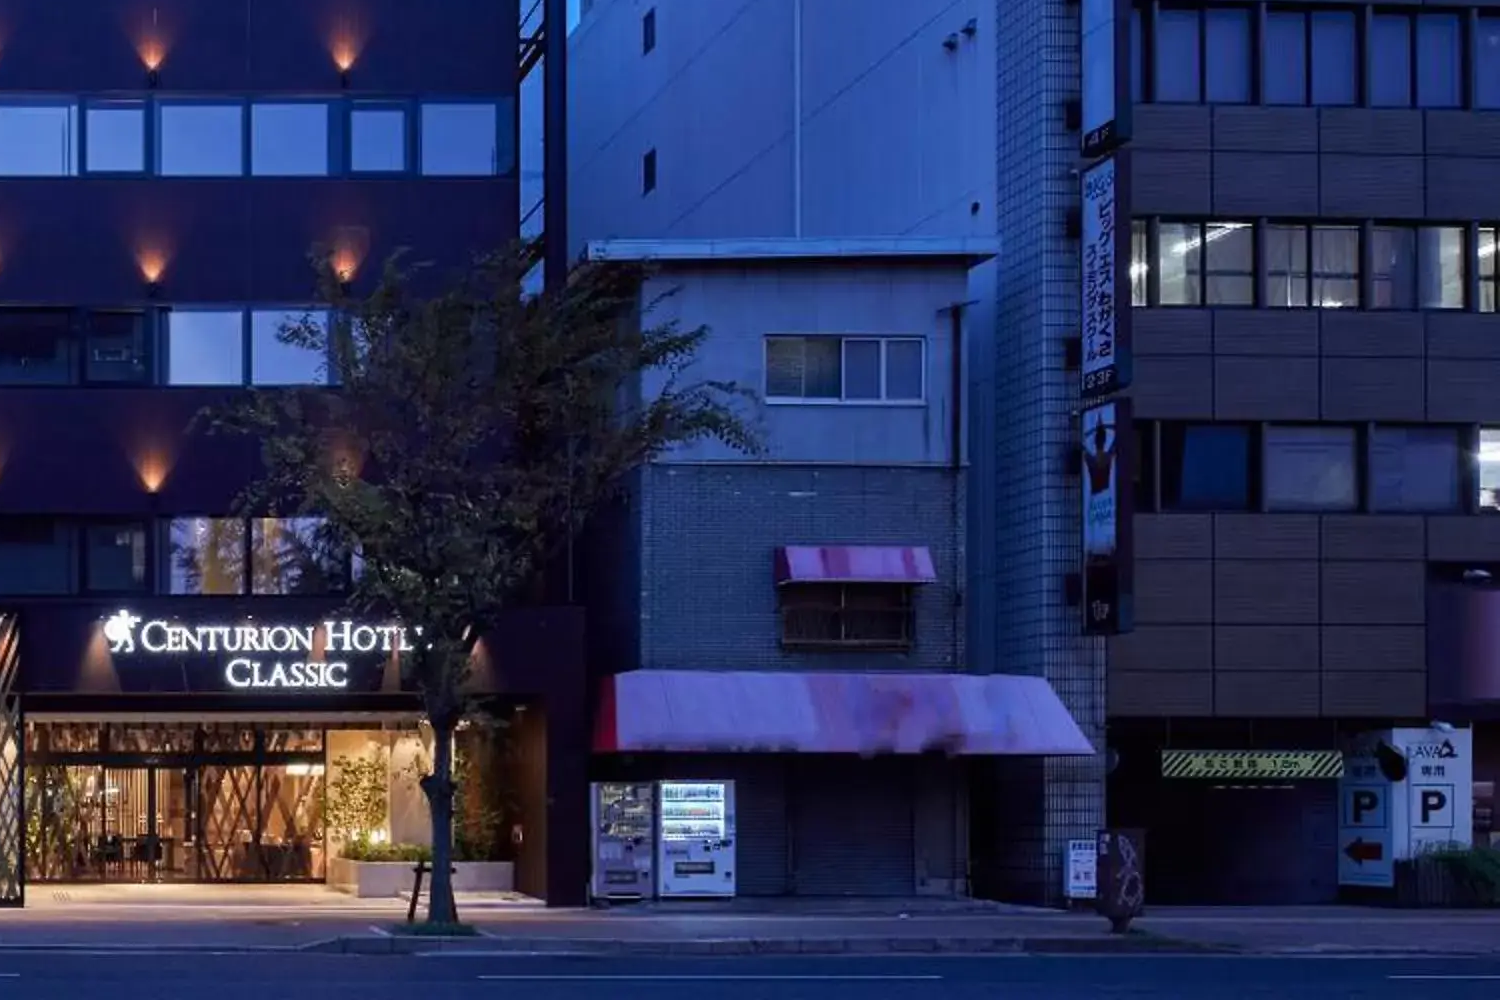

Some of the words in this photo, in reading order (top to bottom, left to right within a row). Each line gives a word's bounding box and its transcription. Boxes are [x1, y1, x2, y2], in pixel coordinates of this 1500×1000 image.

[140, 620, 314, 652] CENTURION
[224, 657, 348, 688] CLASSIC
[1352, 790, 1379, 824] P
[1420, 790, 1447, 824] P
